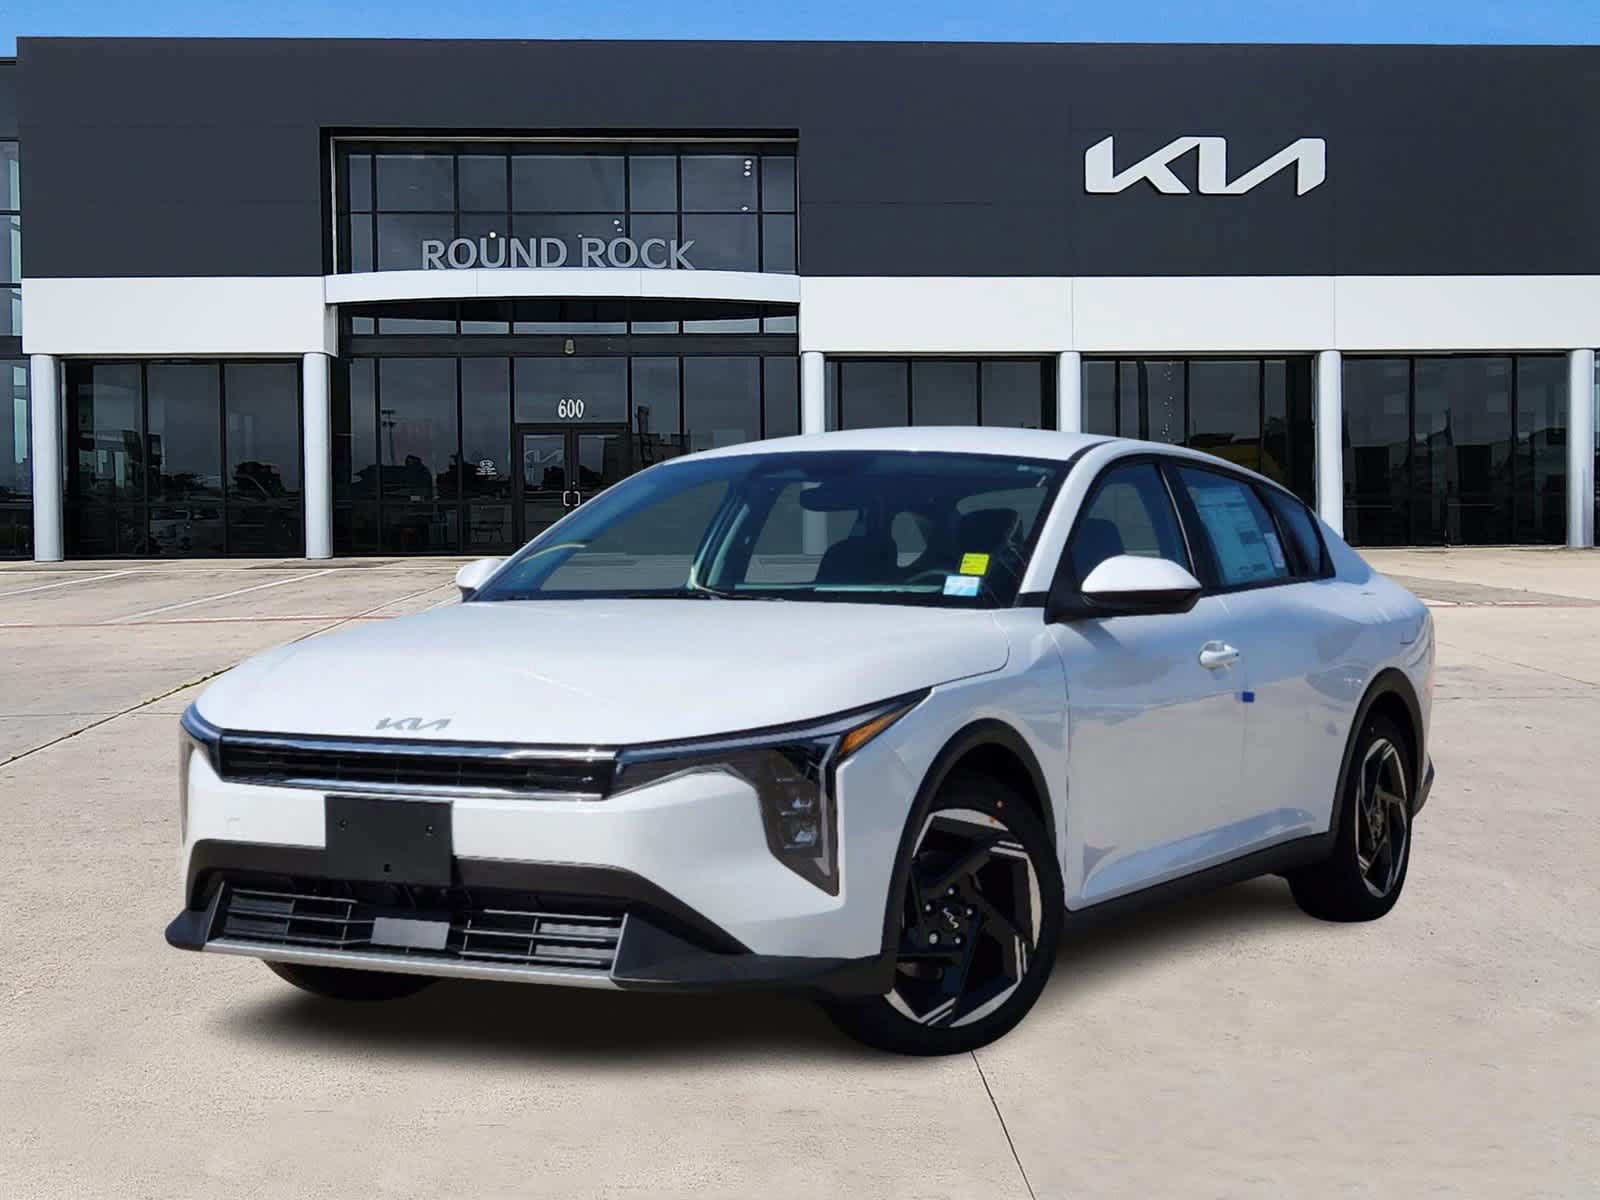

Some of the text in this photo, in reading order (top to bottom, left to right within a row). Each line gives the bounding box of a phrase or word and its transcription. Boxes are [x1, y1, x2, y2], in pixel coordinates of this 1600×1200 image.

[1085, 135, 1326, 196] KIA
[421, 237, 696, 270] ROUND ROCK
[558, 399, 584, 418] 600
